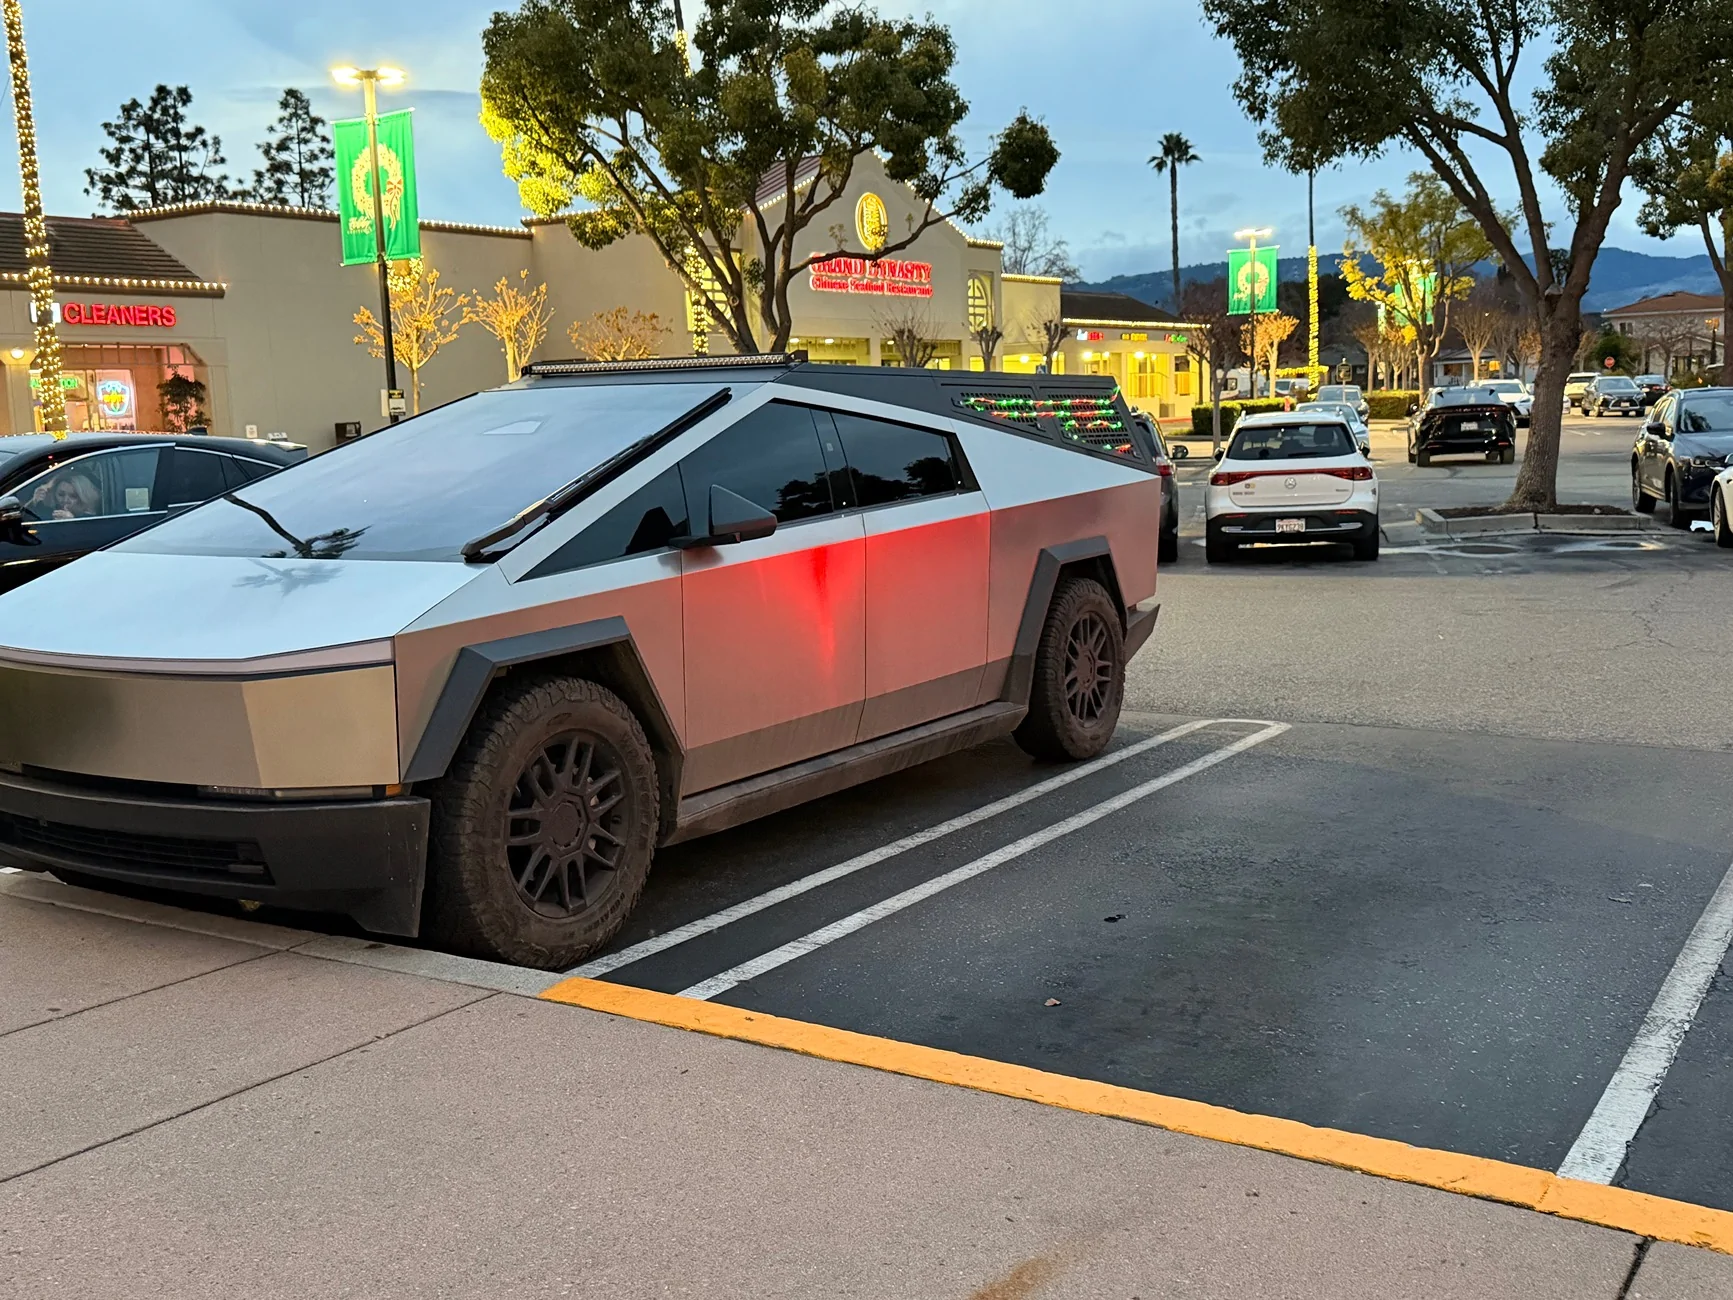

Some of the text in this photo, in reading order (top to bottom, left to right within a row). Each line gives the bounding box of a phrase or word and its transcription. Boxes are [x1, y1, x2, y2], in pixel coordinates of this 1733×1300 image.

[810, 252, 932, 282] GRAND DYNASTY
[810, 276, 932, 297] Chinese Seafood Restaurant
[64, 303, 176, 327] CLEANERS
